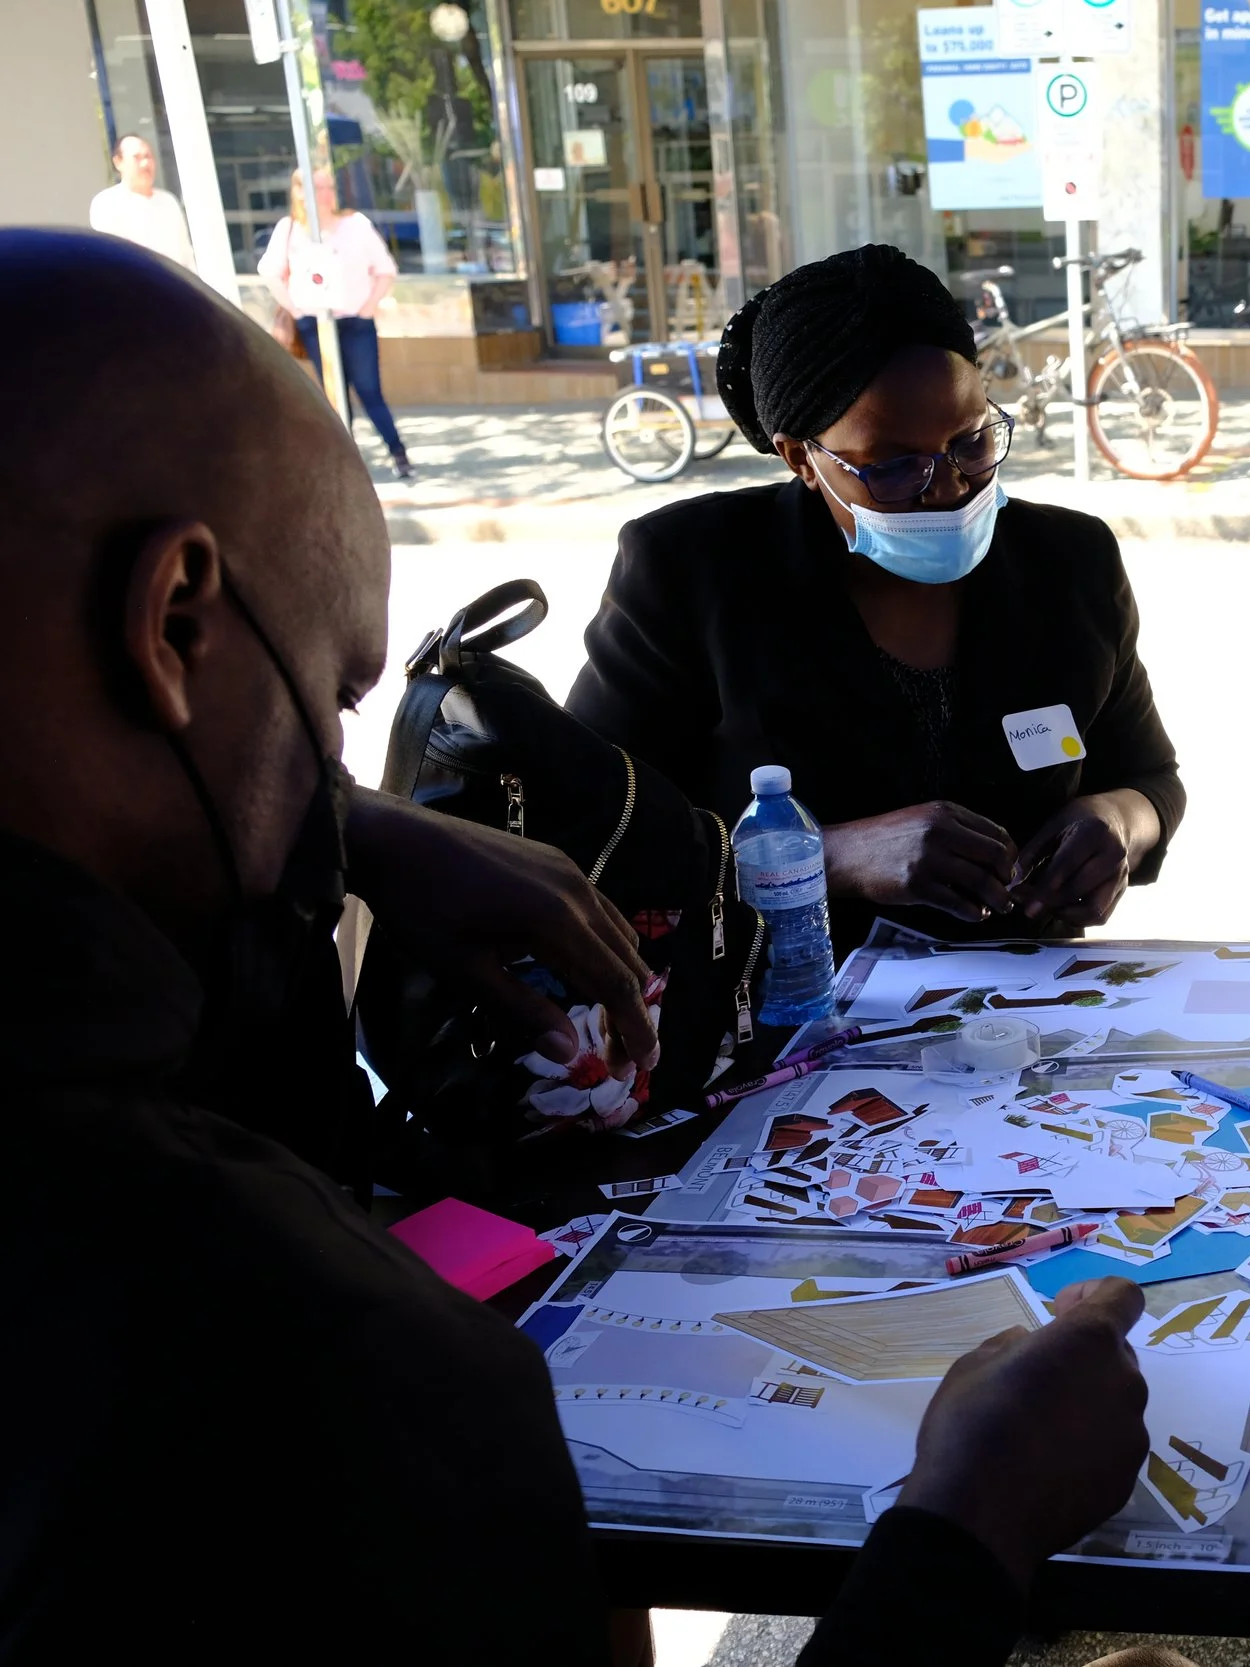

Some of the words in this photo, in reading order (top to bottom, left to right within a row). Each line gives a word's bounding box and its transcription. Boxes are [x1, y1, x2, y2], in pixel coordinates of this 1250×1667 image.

[1204, 8, 1229, 23] Get
[1204, 27, 1219, 40] in
[563, 82, 598, 103] 109
[1060, 84, 1078, 108] P
[1008, 723, 1052, 743] Monica
[728, 1078, 767, 1094] Crayola
[689, 1146, 735, 1192] BELMONT
[788, 1497, 803, 1505] 28
[1155, 1539, 1182, 1551] inch
